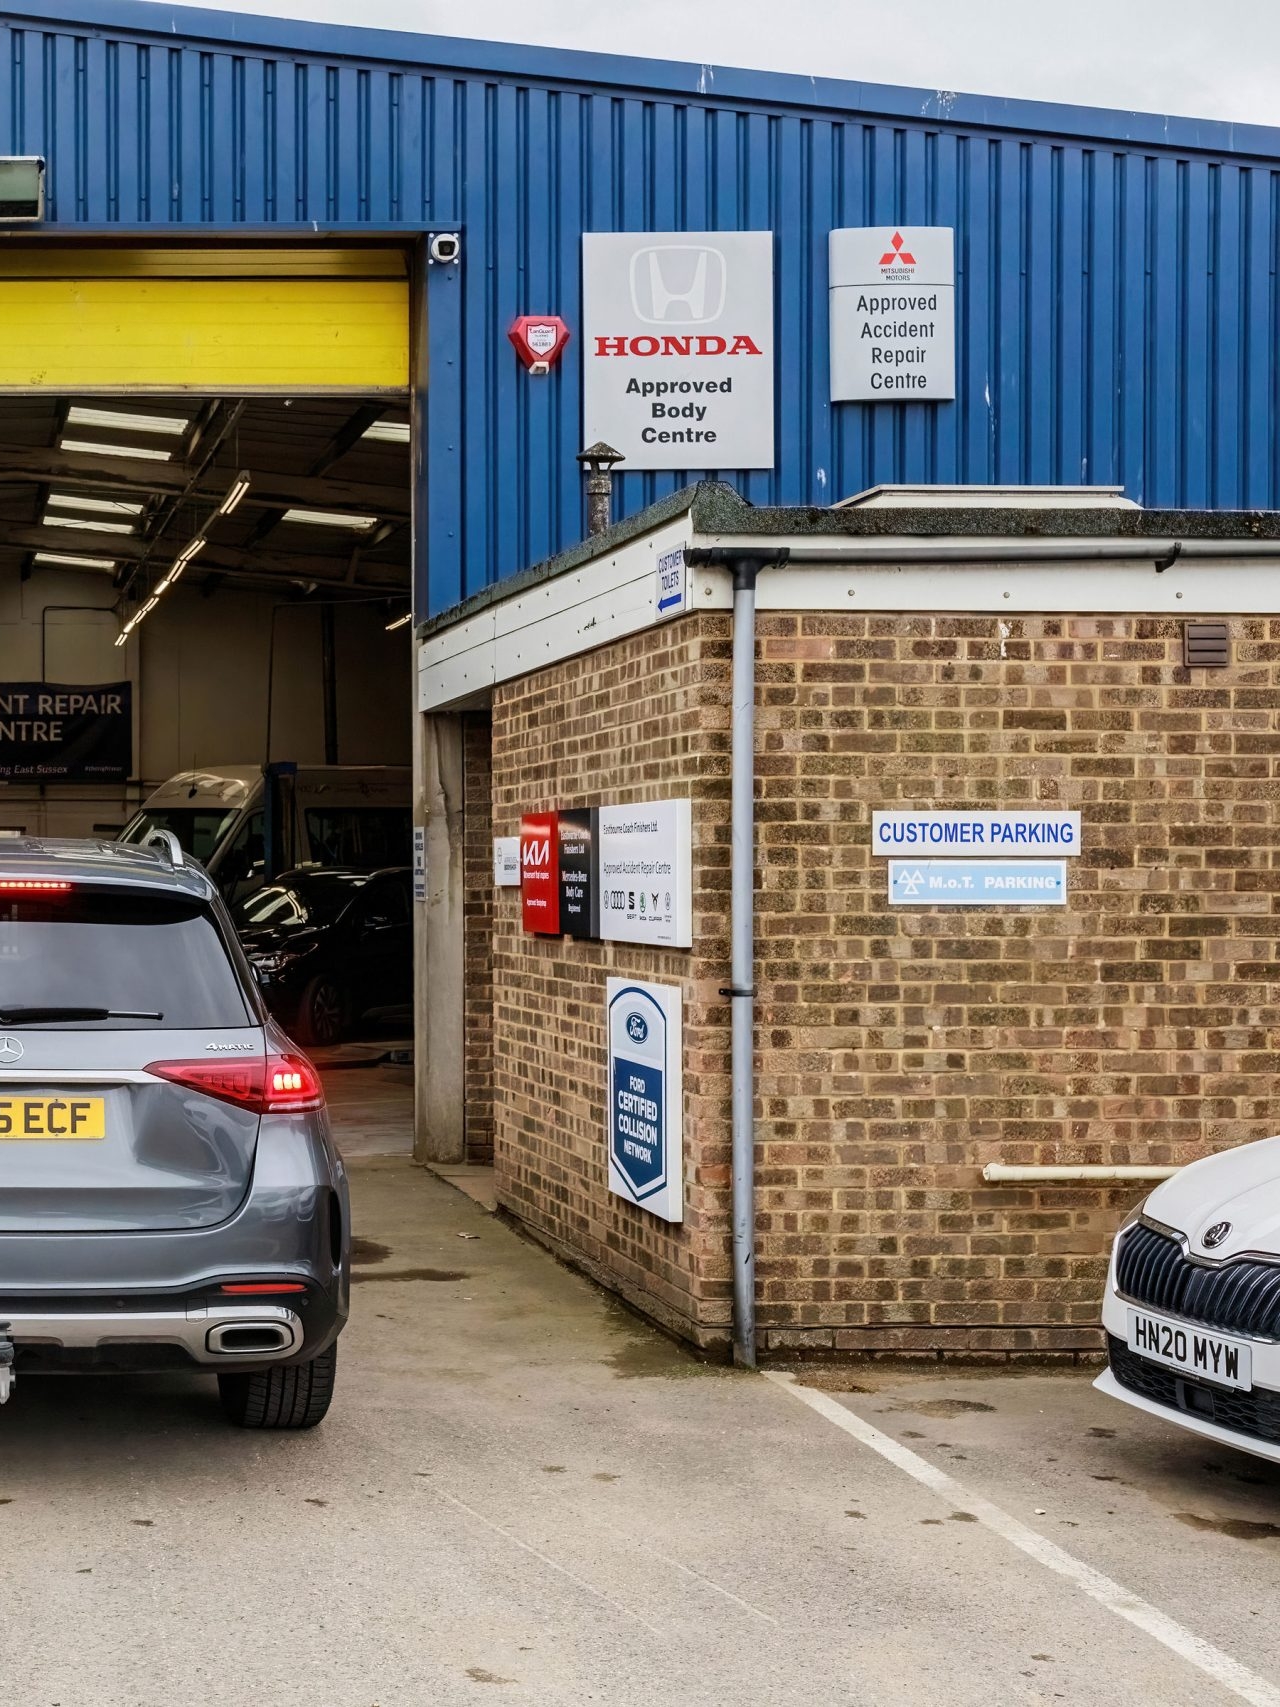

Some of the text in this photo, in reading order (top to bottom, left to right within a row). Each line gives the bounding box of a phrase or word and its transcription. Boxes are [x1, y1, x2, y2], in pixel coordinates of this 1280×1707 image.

[856, 294, 937, 316] Approved
[860, 320, 935, 339] Accident
[594, 336, 762, 357] HONDA
[871, 347, 927, 367] Repair
[625, 377, 732, 397] Approved
[870, 371, 927, 390] Centre
[651, 401, 707, 422] Body
[640, 426, 717, 444] Centre
[658, 549, 683, 573] CUSTOMER
[661, 570, 679, 591] TOILETS
[38, 694, 122, 715] REPAIR
[13, 764, 37, 775] East
[39, 764, 68, 775] Sussex
[879, 822, 1074, 843] CUSTOMER PARKING
[929, 876, 1057, 889] M.o.T. PARKING
[629, 1075, 646, 1094] FORD
[618, 1090, 658, 1122] CERTIFIED
[23, 1102, 91, 1134] ECF
[618, 1113, 658, 1146] COLLISION
[623, 1138, 652, 1165] NETWORK
[1134, 1315, 1239, 1381] HN20 MYW
